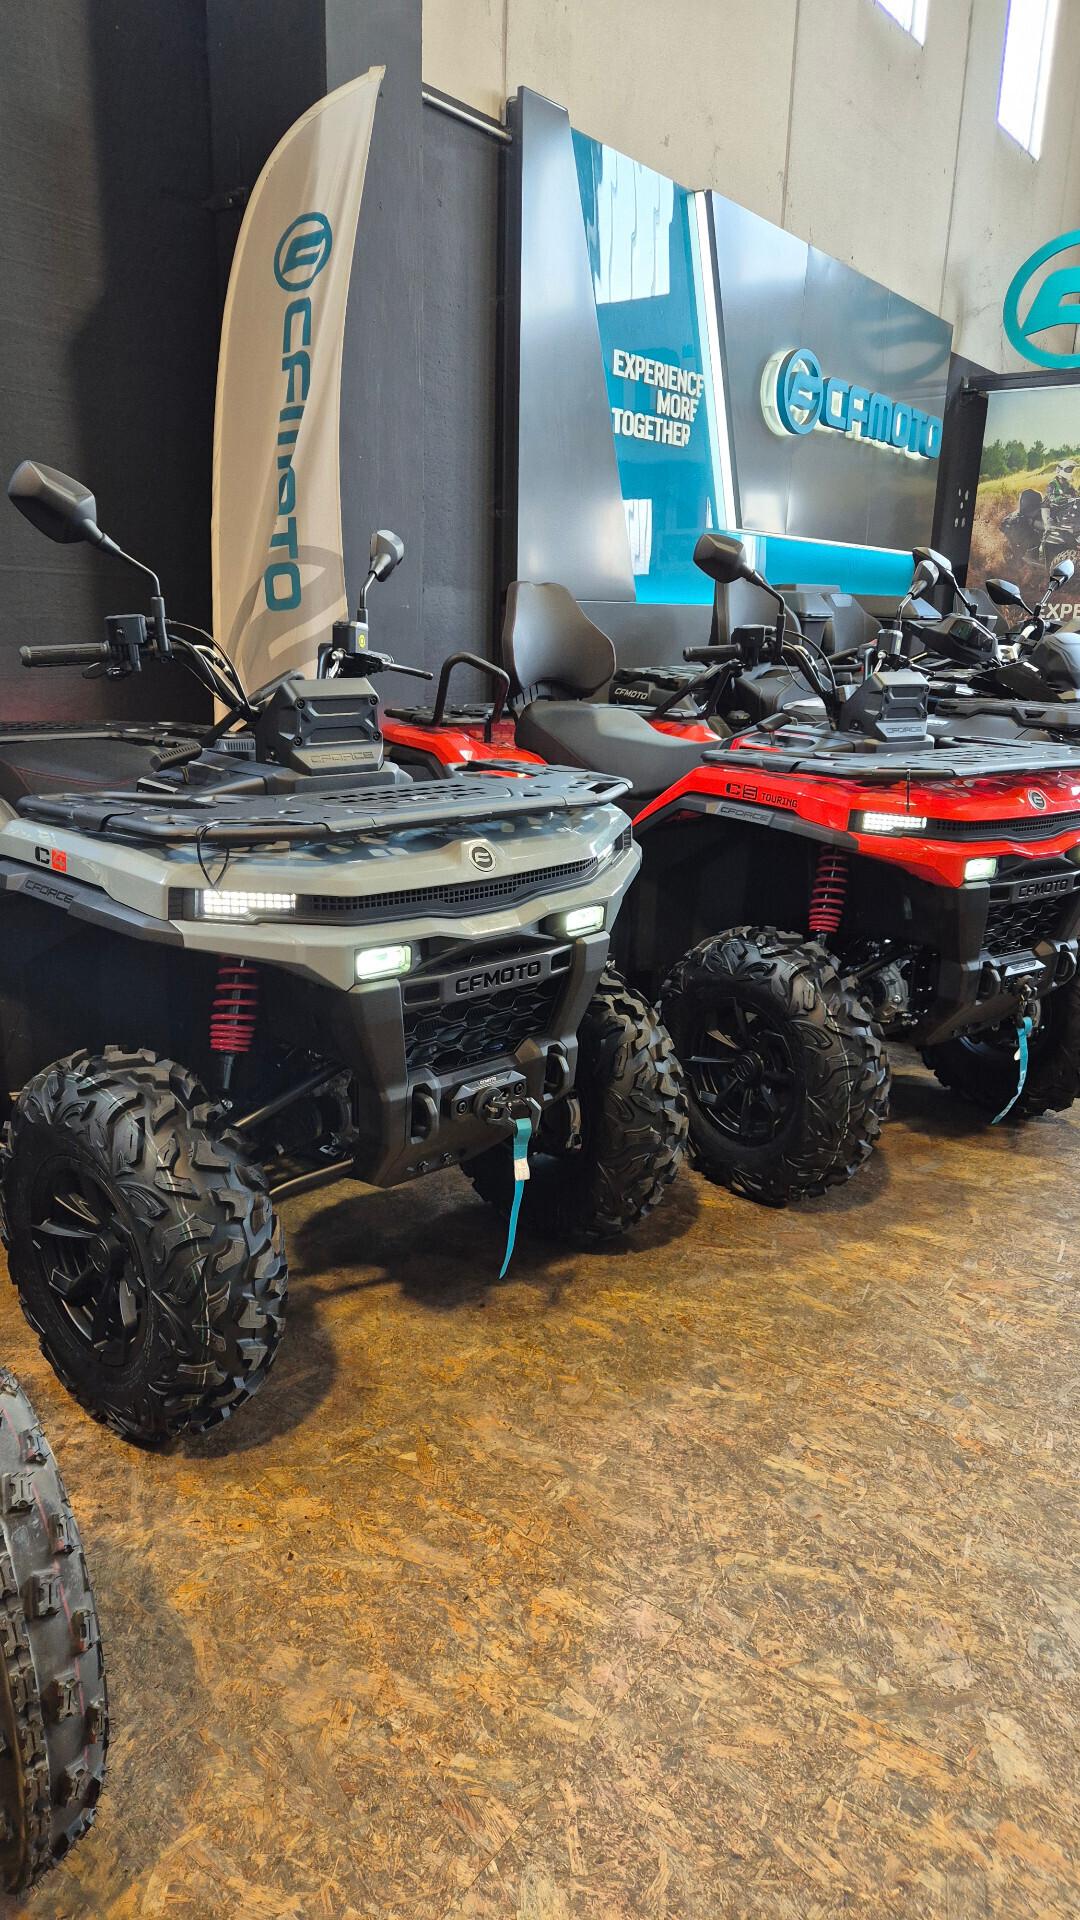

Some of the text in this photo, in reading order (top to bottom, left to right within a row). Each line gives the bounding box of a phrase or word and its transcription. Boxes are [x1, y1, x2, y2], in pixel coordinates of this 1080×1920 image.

[612, 348, 704, 398] EXPERIENCE
[656, 389, 699, 423] MORE
[818, 377, 944, 459] CFMOTO
[611, 407, 692, 447] TOGETHER
[614, 687, 649, 700] CFMOTO
[720, 806, 770, 821] CFORCE
[761, 792, 798, 808] TOURING
[24, 879, 74, 904] CFORCE
[1018, 879, 1069, 899] CFMOTO
[455, 960, 541, 995] CFMOTO
